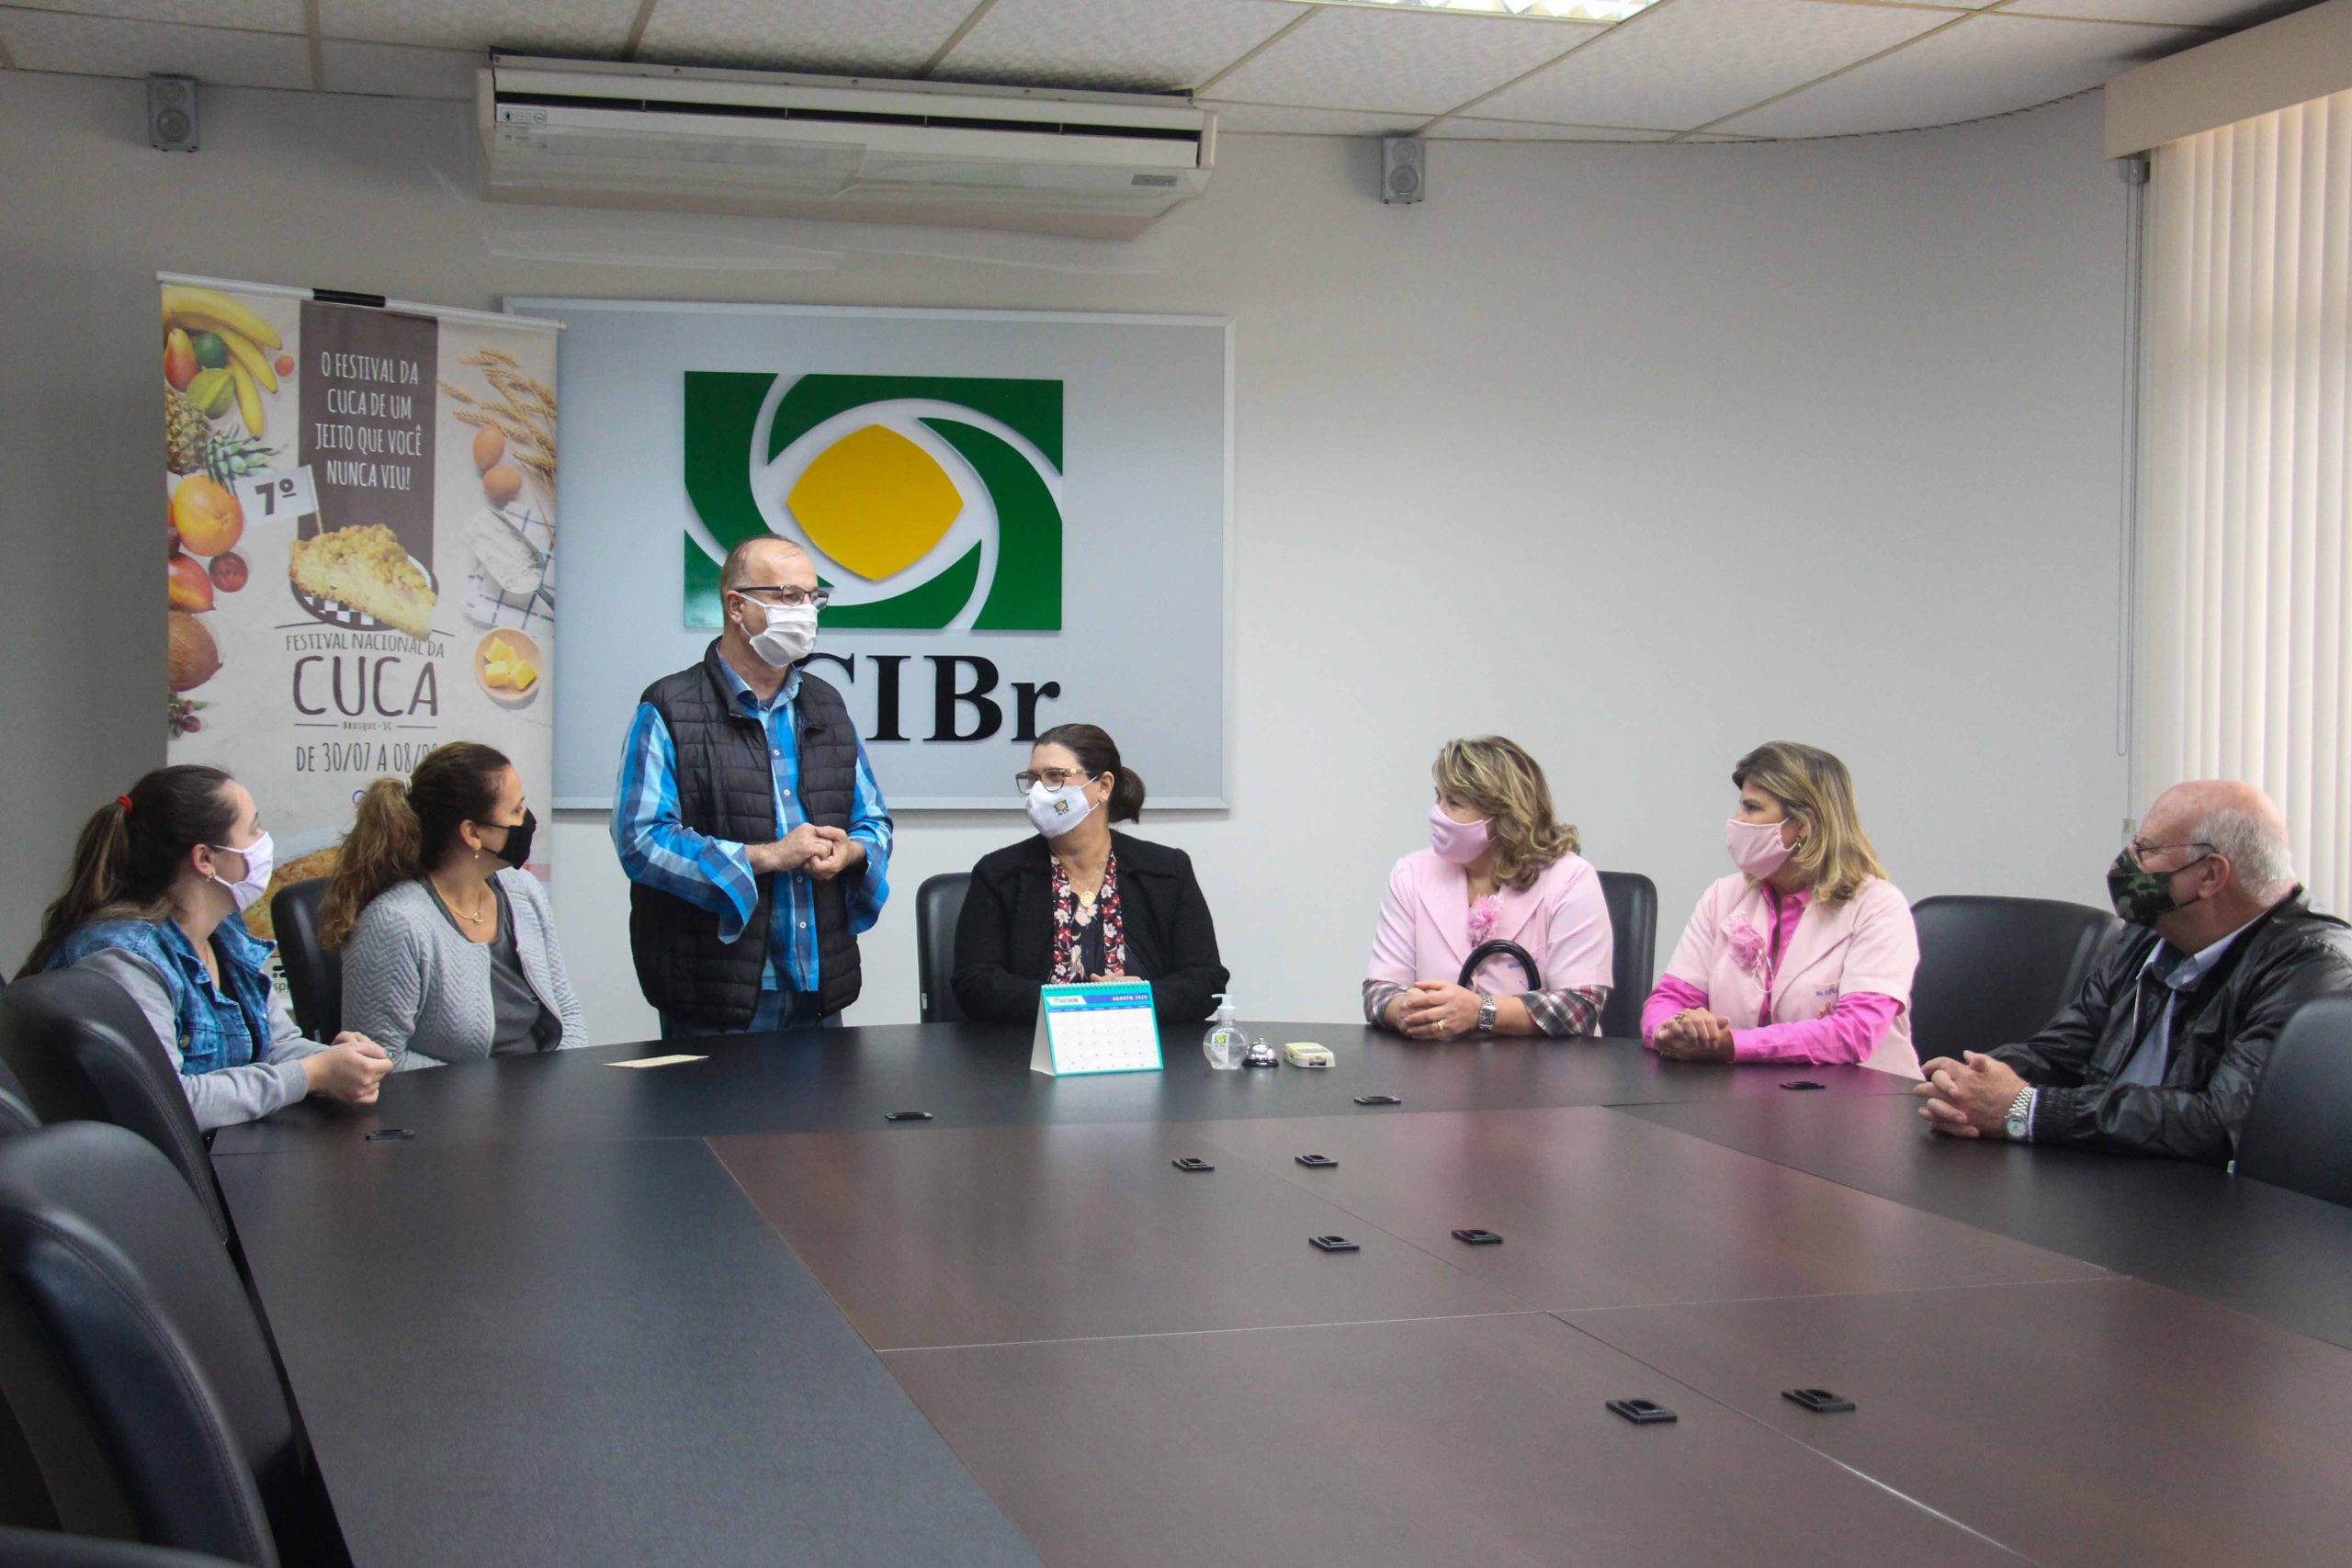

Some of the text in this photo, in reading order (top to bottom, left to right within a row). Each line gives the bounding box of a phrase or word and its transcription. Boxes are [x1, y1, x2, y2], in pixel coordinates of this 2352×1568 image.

[322, 352, 418, 385] O FESTIVAL DA
[327, 389, 412, 420] CUCA DE UM
[315, 423, 423, 456] JEITO QUE VOCÊ
[327, 460, 411, 491] NUNCA VIU!
[286, 633, 444, 658] FESTIVAL NACIONAL DA
[292, 655, 438, 716] CUCA
[296, 746, 315, 772] DE
[322, 742, 370, 772] 30/07
[377, 744, 387, 772] A
